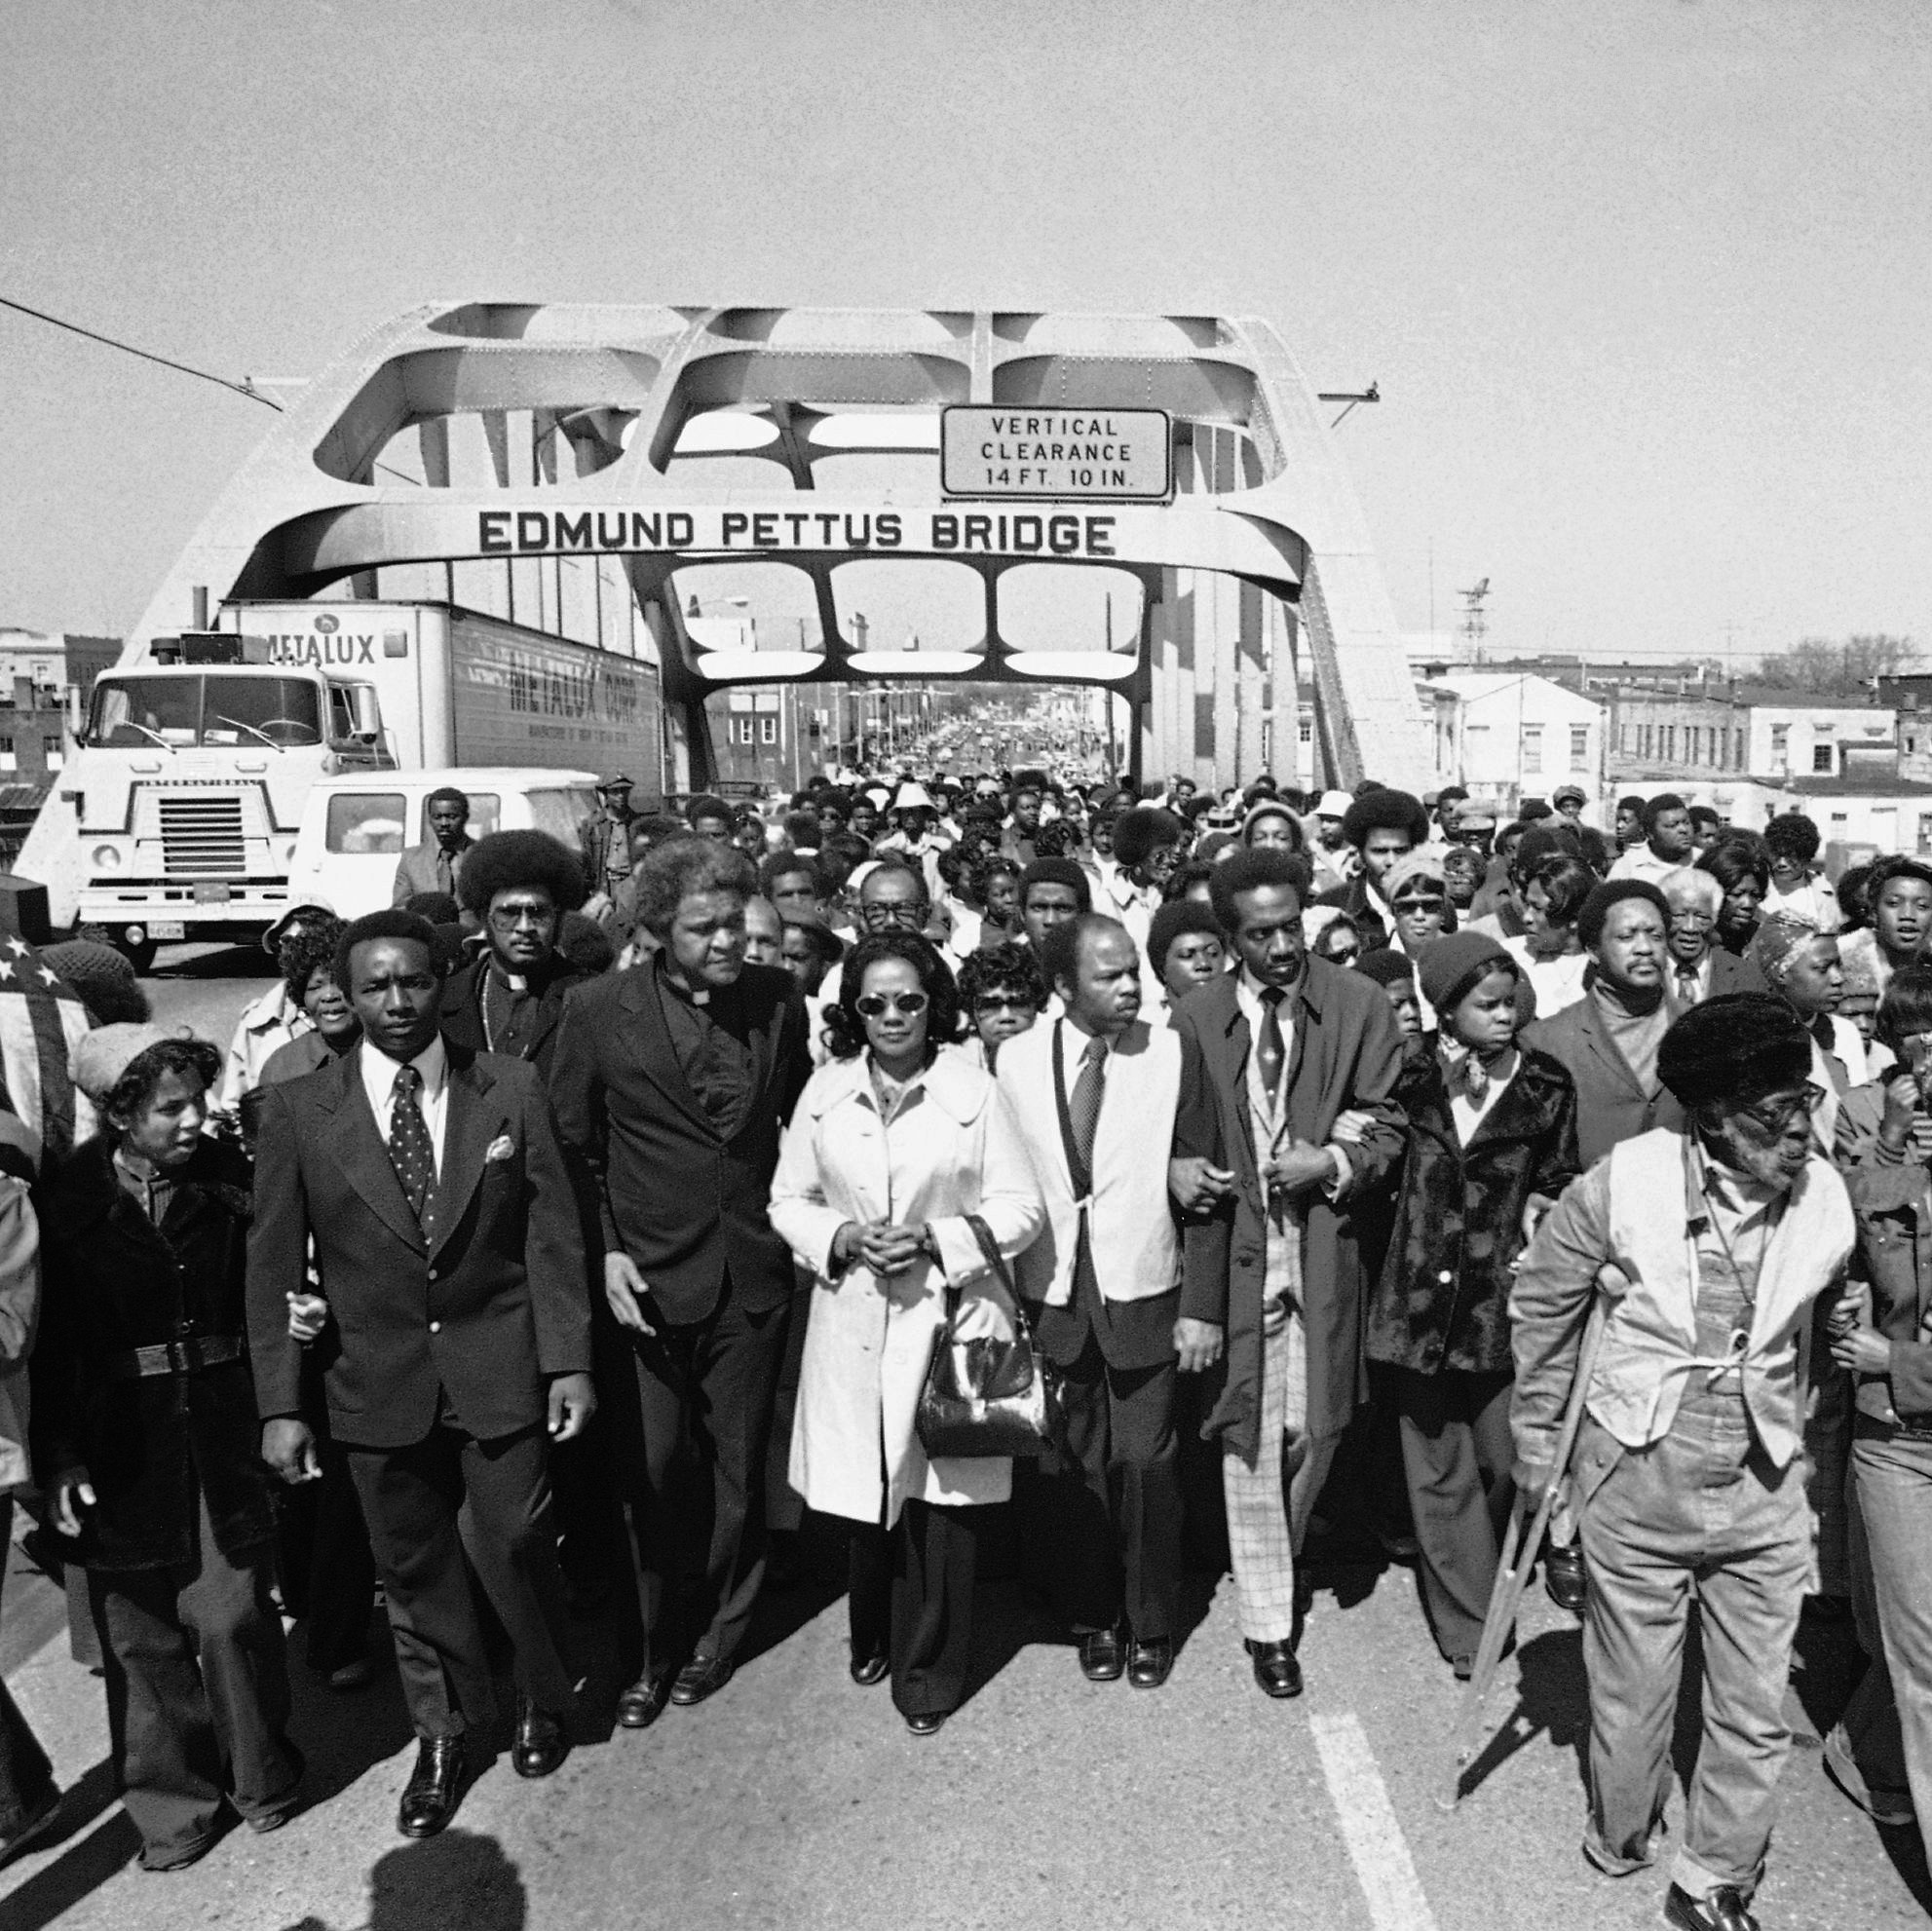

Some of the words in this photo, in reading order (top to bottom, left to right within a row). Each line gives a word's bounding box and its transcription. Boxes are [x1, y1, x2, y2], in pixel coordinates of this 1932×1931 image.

[991, 416, 1118, 437] VERTICAL
[979, 442, 1131, 463] CLEARANCE
[987, 468, 1010, 486] 14
[1070, 469, 1093, 487] 10
[478, 511, 695, 553] EDMUND
[721, 512, 903, 549] PETTUS
[930, 514, 1117, 556] BRIDGE
